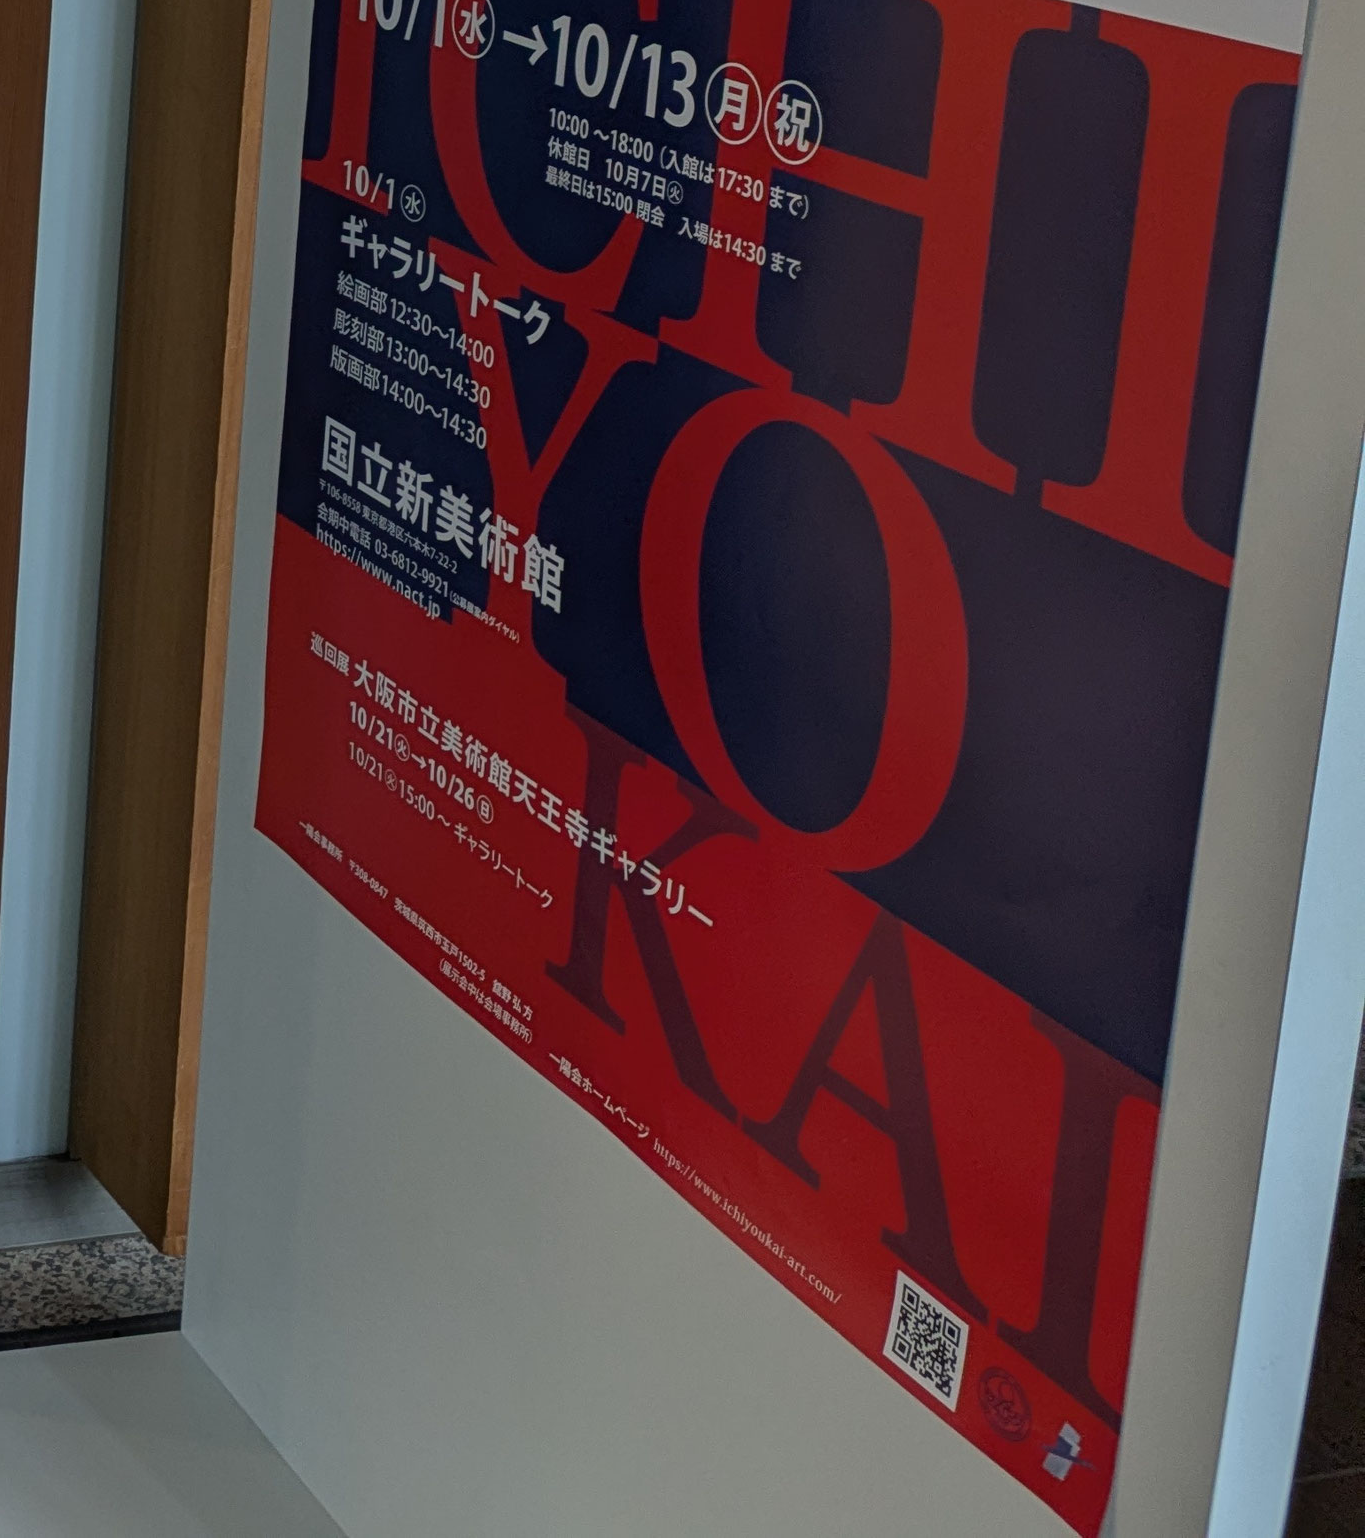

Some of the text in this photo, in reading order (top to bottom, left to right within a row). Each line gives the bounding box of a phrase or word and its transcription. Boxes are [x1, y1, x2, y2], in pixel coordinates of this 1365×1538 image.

[547, 135, 591, 171] 休館日
[548, 107, 590, 140] 10:00
[340, 214, 552, 346] ギャラリートーク
[315, 522, 441, 621] https://www.nact.jp
[316, 501, 450, 598] 会期中電話 03-6812-9921
[321, 415, 566, 614] 国立新美術館
[310, 631, 715, 929] 巡回展 大阪市立美術館天王寺ギャラリー
[453, 821, 554, 909] ギャラリートーク
[545, 698, 1162, 1436] KAI
[548, 1052, 844, 1305] 一陽会ホームページ https://www.ichiyoukai-art.com/
